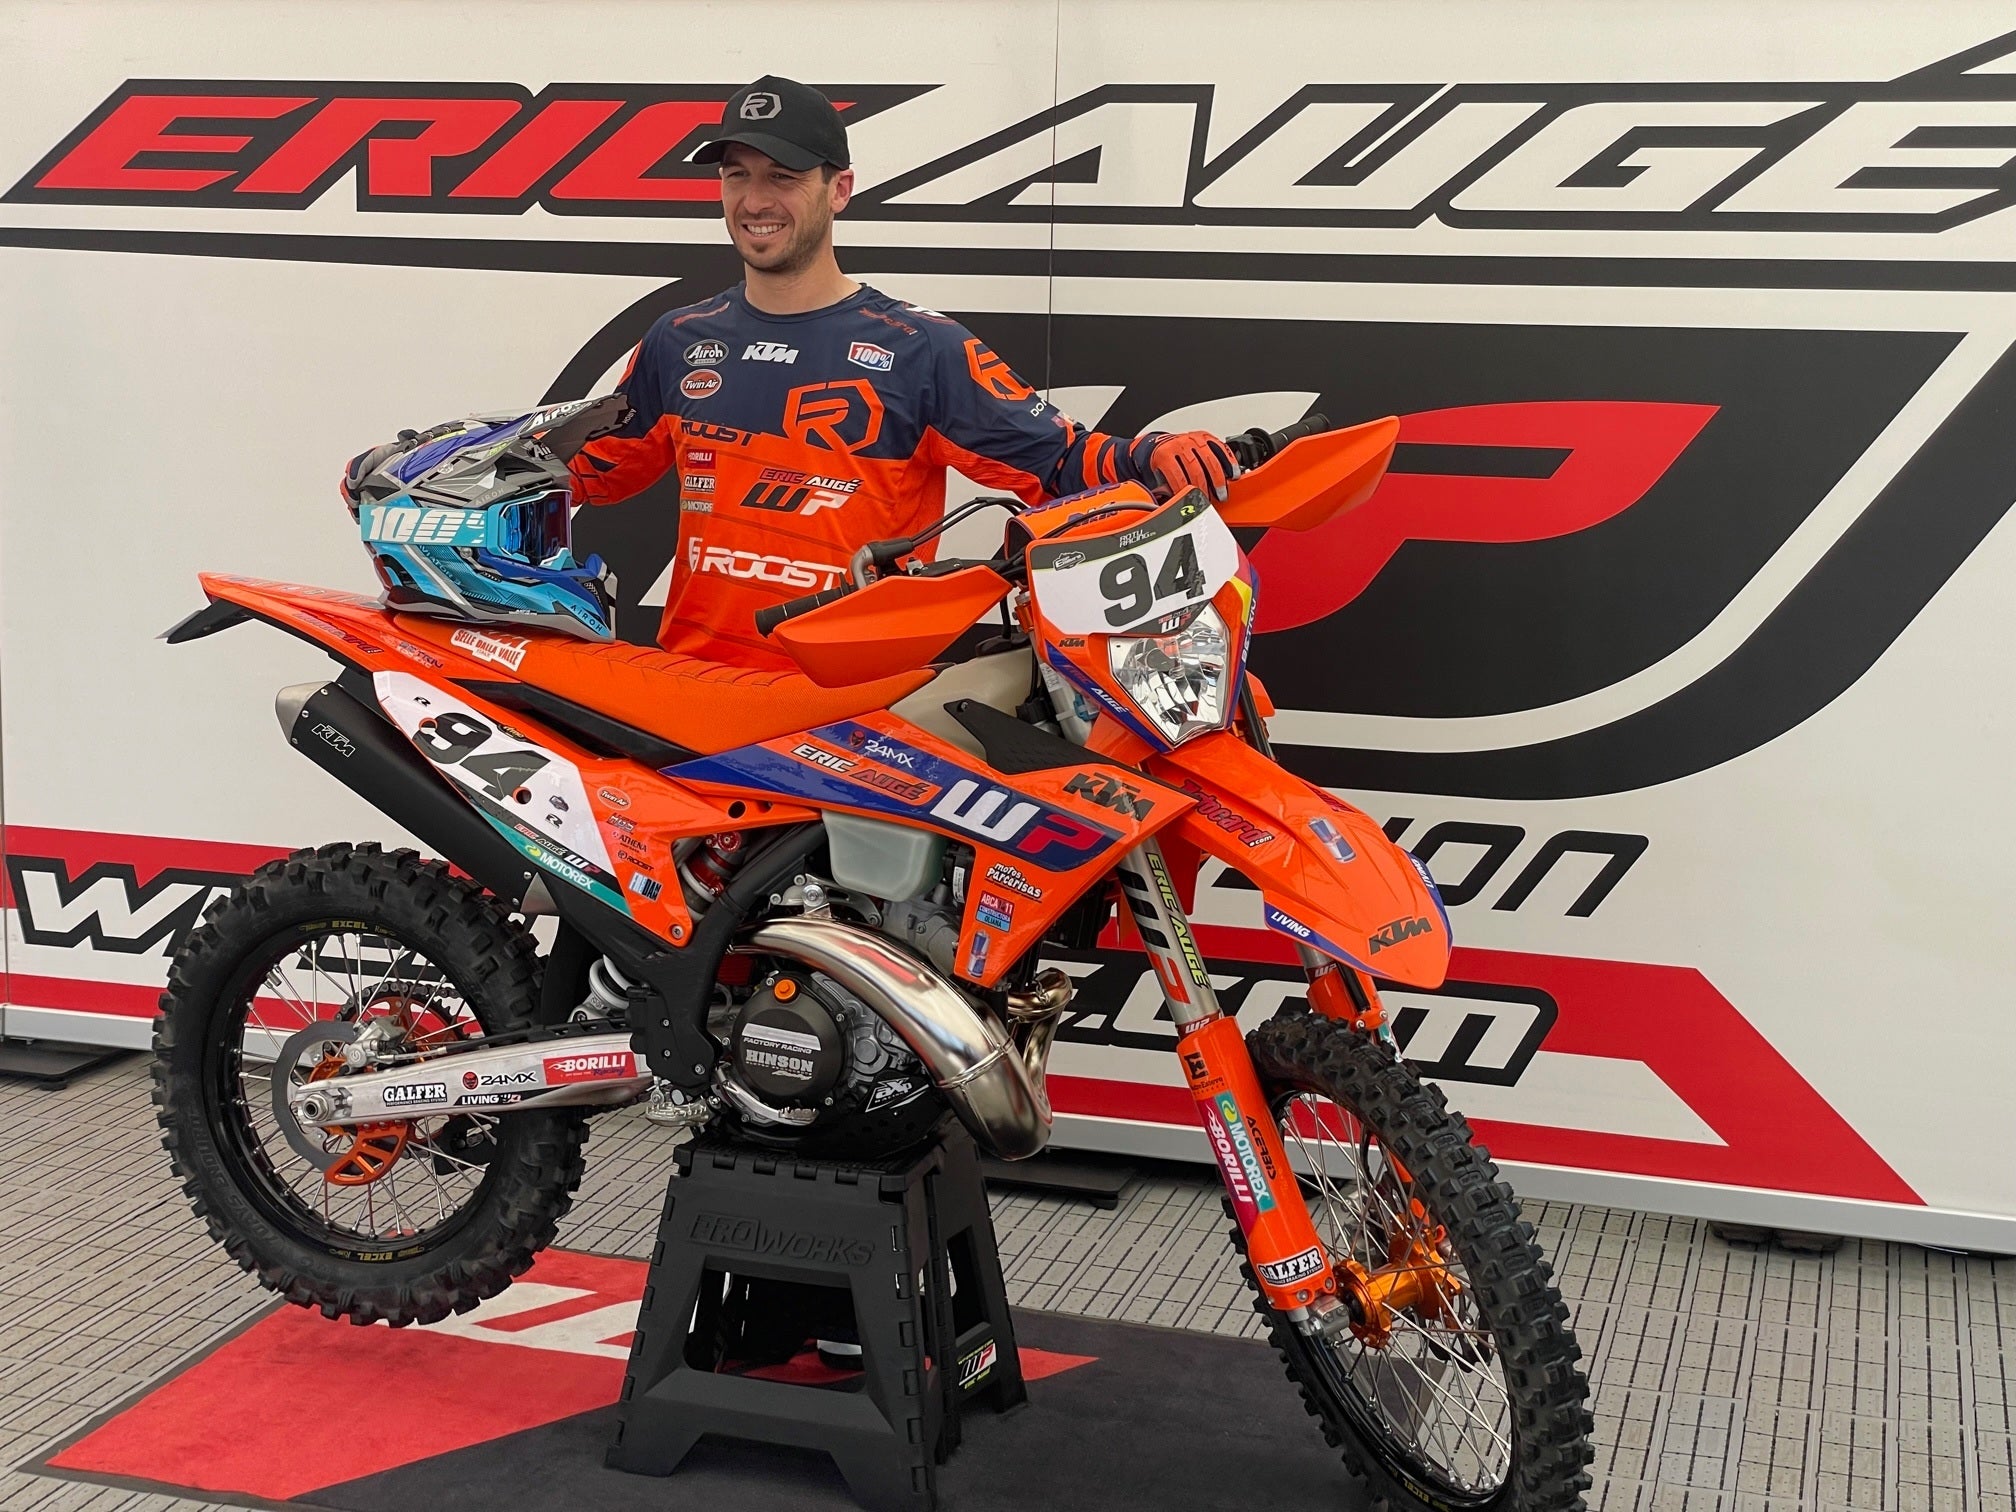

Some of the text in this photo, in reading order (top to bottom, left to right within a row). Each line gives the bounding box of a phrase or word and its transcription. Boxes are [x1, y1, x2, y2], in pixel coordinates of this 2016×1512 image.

[688, 344, 723, 359] Airoh
[741, 341, 799, 364] KTM
[854, 347, 890, 368] 100%
[685, 379, 719, 390] Twin Air
[684, 475, 715, 489] GALFER
[759, 467, 864, 494] ERIC AUGÉ
[740, 482, 850, 516] WP
[702, 546, 848, 590] ROOST
[1099, 533, 1207, 628] 94
[570, 604, 603, 632] AIROH
[454, 629, 522, 666] SELLE DALLA VALLE
[311, 723, 356, 758] KTM
[864, 739, 915, 769] 24MX
[412, 712, 551, 802] 94
[791, 743, 930, 800] ERIC AUGÉ
[1062, 772, 1155, 822] KTM
[929, 778, 1106, 853] WP
[619, 834, 648, 853] ATHENA
[540, 852, 594, 890] MOTOREX
[626, 857, 655, 871] ROOST
[1146, 852, 1181, 913] ERIC
[331, 920, 369, 930] EXCEL
[1271, 911, 1311, 938] LIVING
[1368, 916, 1433, 956] KTM
[743, 1037, 813, 1055] FACTORY RACING
[562, 1054, 627, 1073] BORILLI
[745, 1049, 814, 1073] HINSON
[481, 1072, 537, 1086] 24MX
[383, 1084, 447, 1102] GALFER
[461, 1094, 500, 1105] LIVING
[1208, 1120, 1254, 1203] BORILLI
[1229, 1121, 1271, 1203] MOTOREX
[357, 1251, 394, 1261] EXCEL
